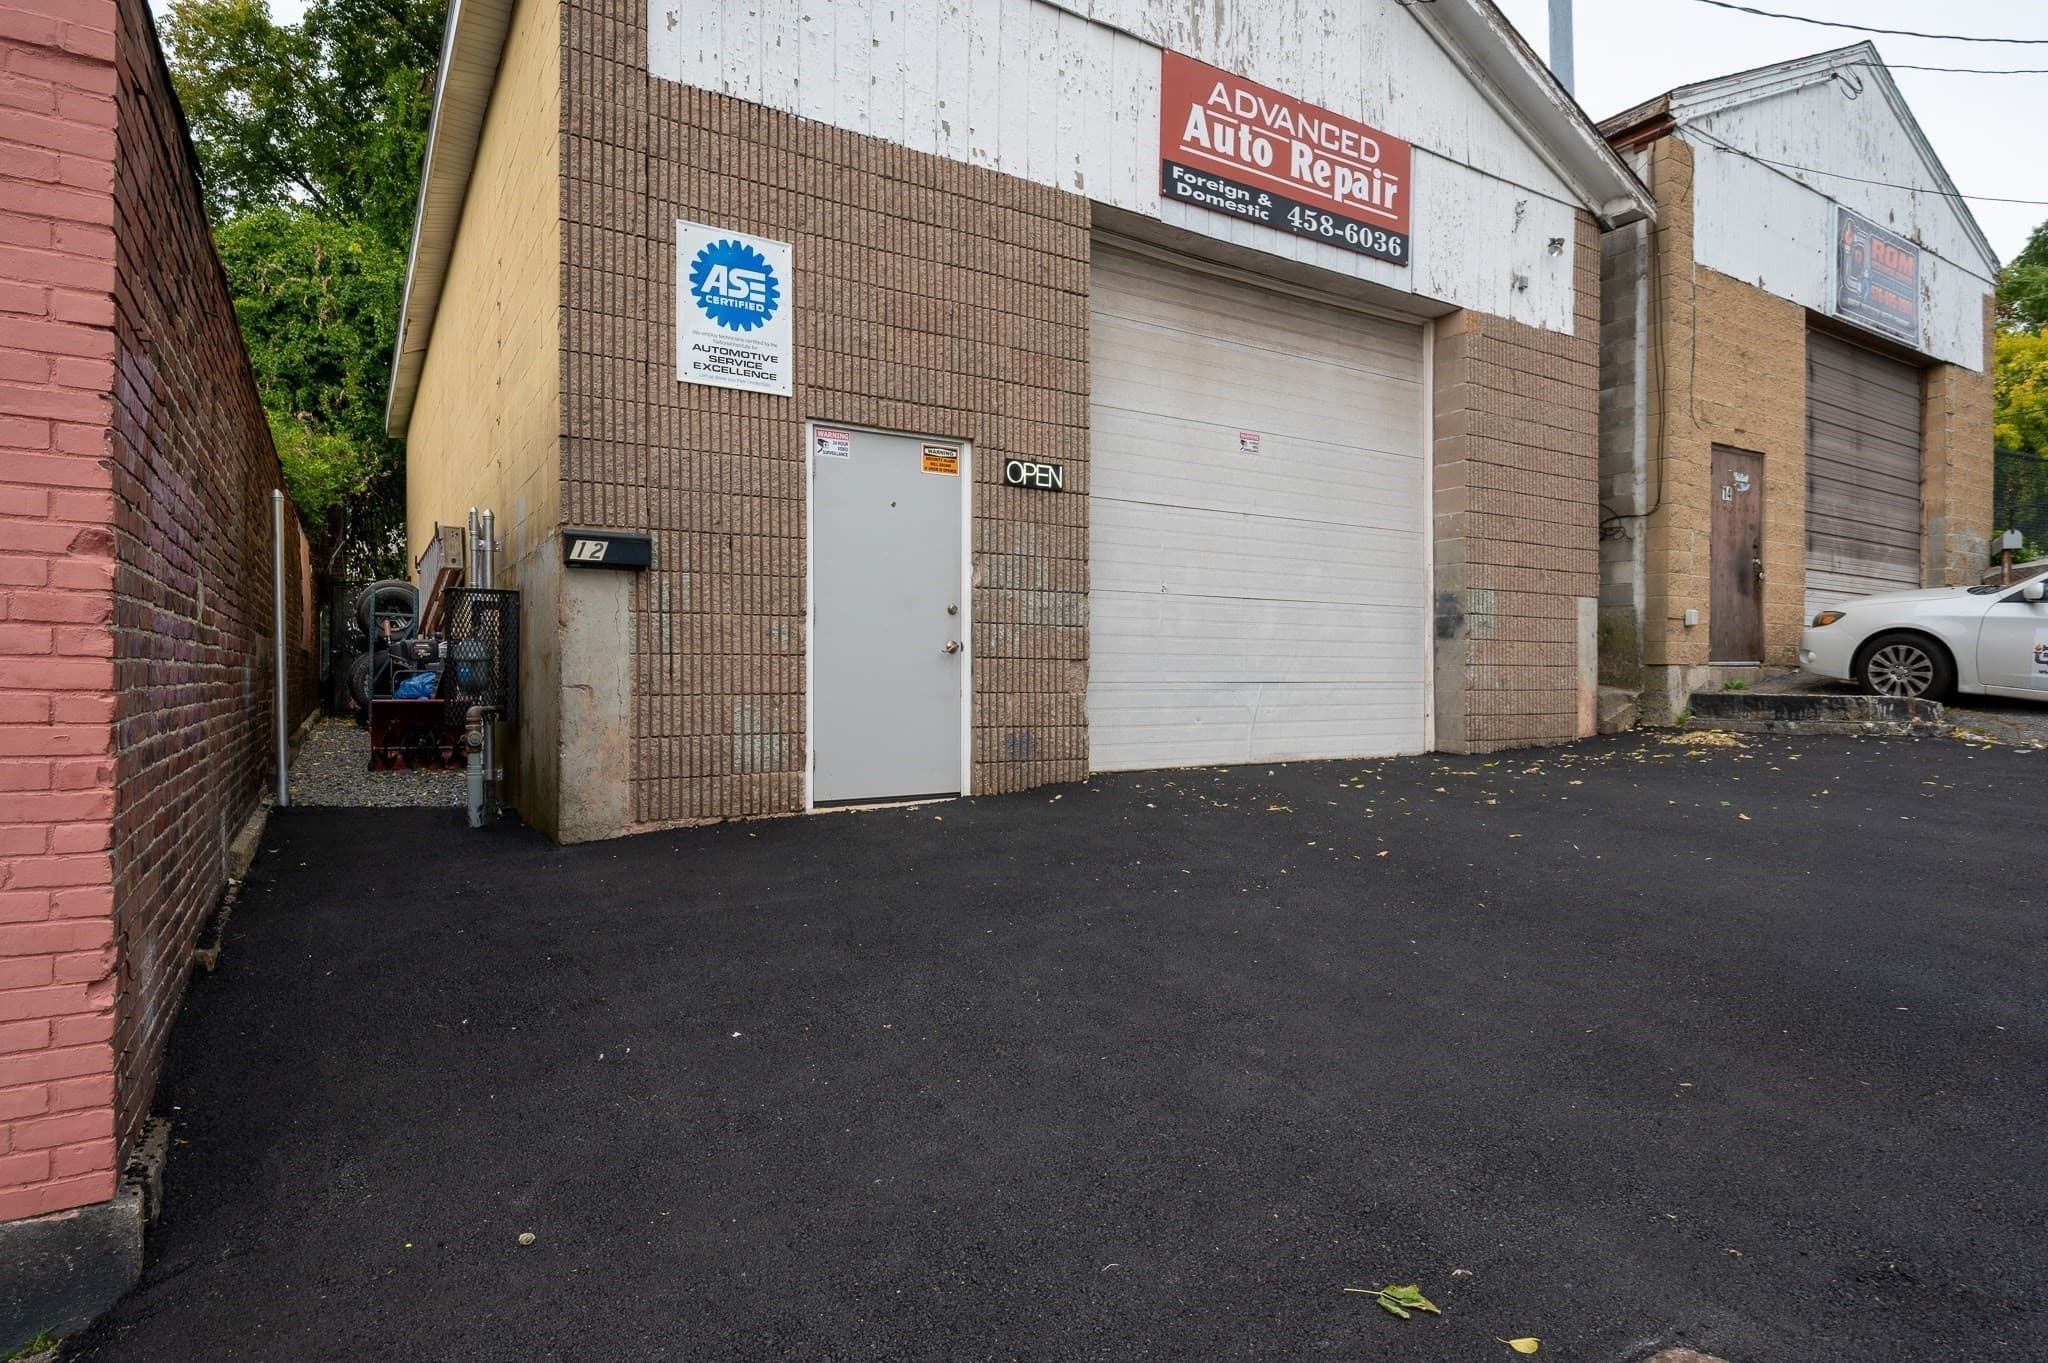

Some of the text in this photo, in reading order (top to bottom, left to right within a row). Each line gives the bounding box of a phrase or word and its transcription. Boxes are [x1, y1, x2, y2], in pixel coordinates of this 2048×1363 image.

[1207, 81, 1380, 164] ADVANCED
[1182, 103, 1398, 210] Auto Repair
[1172, 166, 1273, 208] Foreign &
[1177, 182, 1270, 221] Domestic
[1287, 206, 1402, 257] 458-6036
[701, 264, 766, 303] ASE
[705, 294, 765, 313] CERTIFIED
[692, 343, 779, 364] AUTOMOTIVE
[708, 355, 763, 370] SERVICE
[693, 361, 777, 381] EXCELLENCE
[817, 430, 849, 440] WARNING
[927, 449, 954, 457] WARNING
[1006, 460, 1063, 489] OPEN
[577, 541, 604, 559] 12
